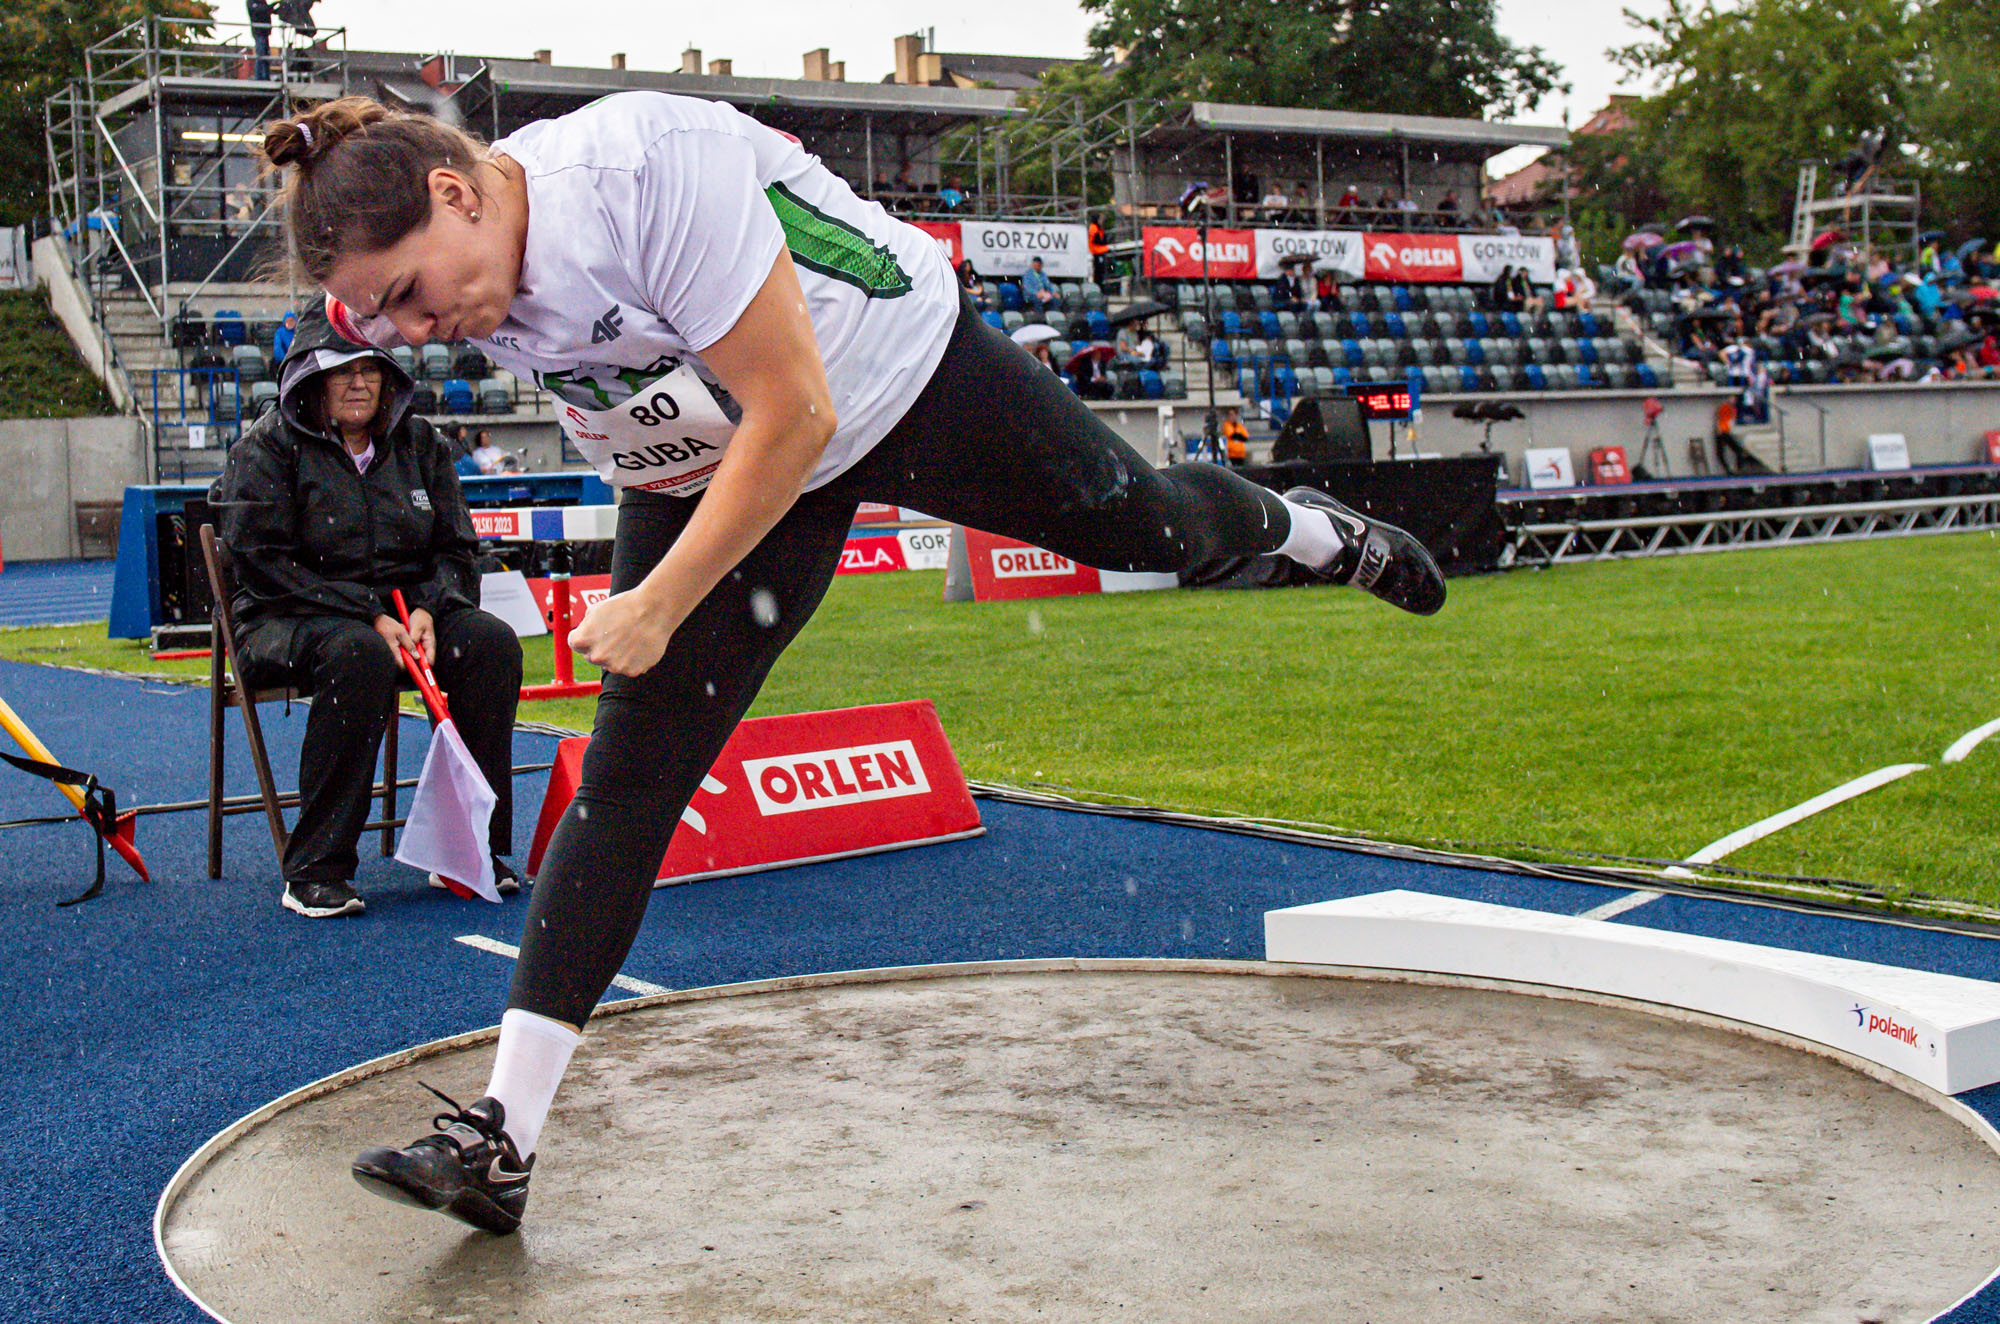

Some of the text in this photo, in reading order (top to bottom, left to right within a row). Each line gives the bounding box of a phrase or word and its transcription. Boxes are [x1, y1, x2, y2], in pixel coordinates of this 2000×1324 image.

[982, 226, 1069, 250] GORZÓW
[1272, 233, 1347, 255] GORZÓW
[1189, 241, 1249, 263] ORLEN
[1400, 247, 1456, 267] ORLEN
[630, 392, 680, 427] 80
[612, 437, 720, 471] GUBA
[494, 516, 512, 533] 2023
[838, 548, 894, 569] ZLA
[998, 552, 1069, 573] ORLEN
[759, 750, 917, 805] ORLEN
[1868, 1014, 1918, 1048] polanik
